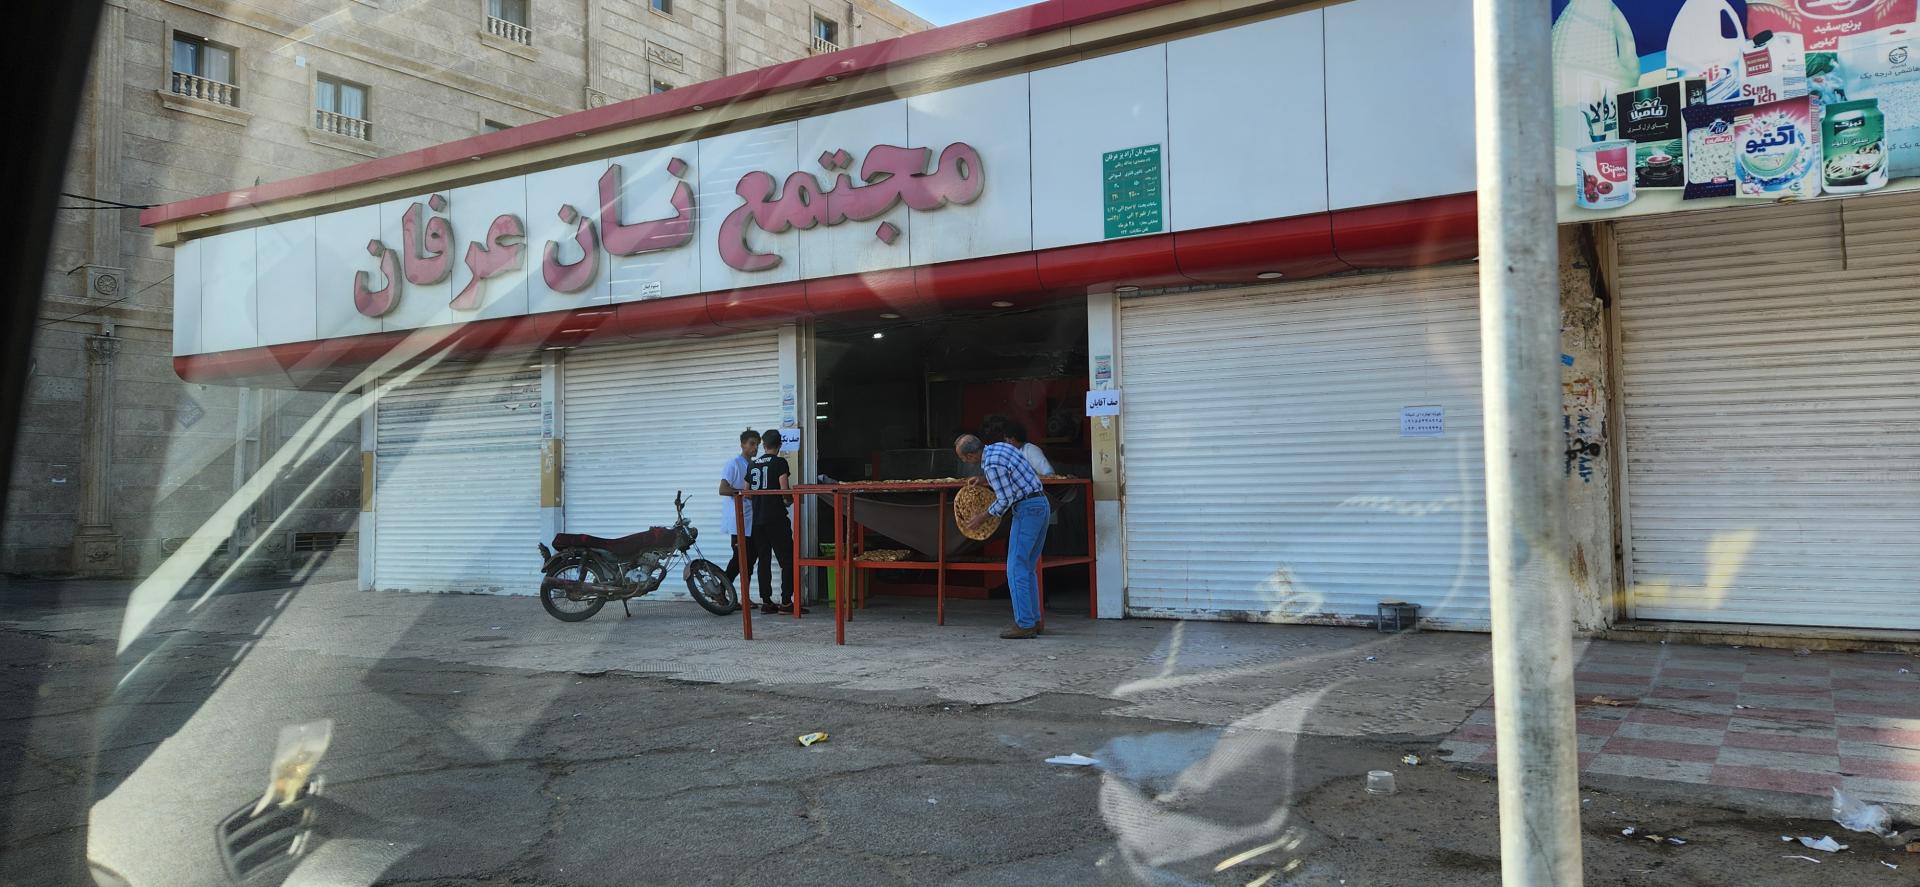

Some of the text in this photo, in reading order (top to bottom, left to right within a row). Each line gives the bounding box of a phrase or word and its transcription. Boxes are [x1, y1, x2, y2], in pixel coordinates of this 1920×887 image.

[1813, 22, 1841, 34] سفید
[1748, 63, 1770, 72] NECTAR
[1743, 84, 1769, 97] Sun
[1757, 89, 1777, 103] ich
[354, 141, 985, 318] مجتمع نان عرفان
[751, 465, 768, 491] 31
